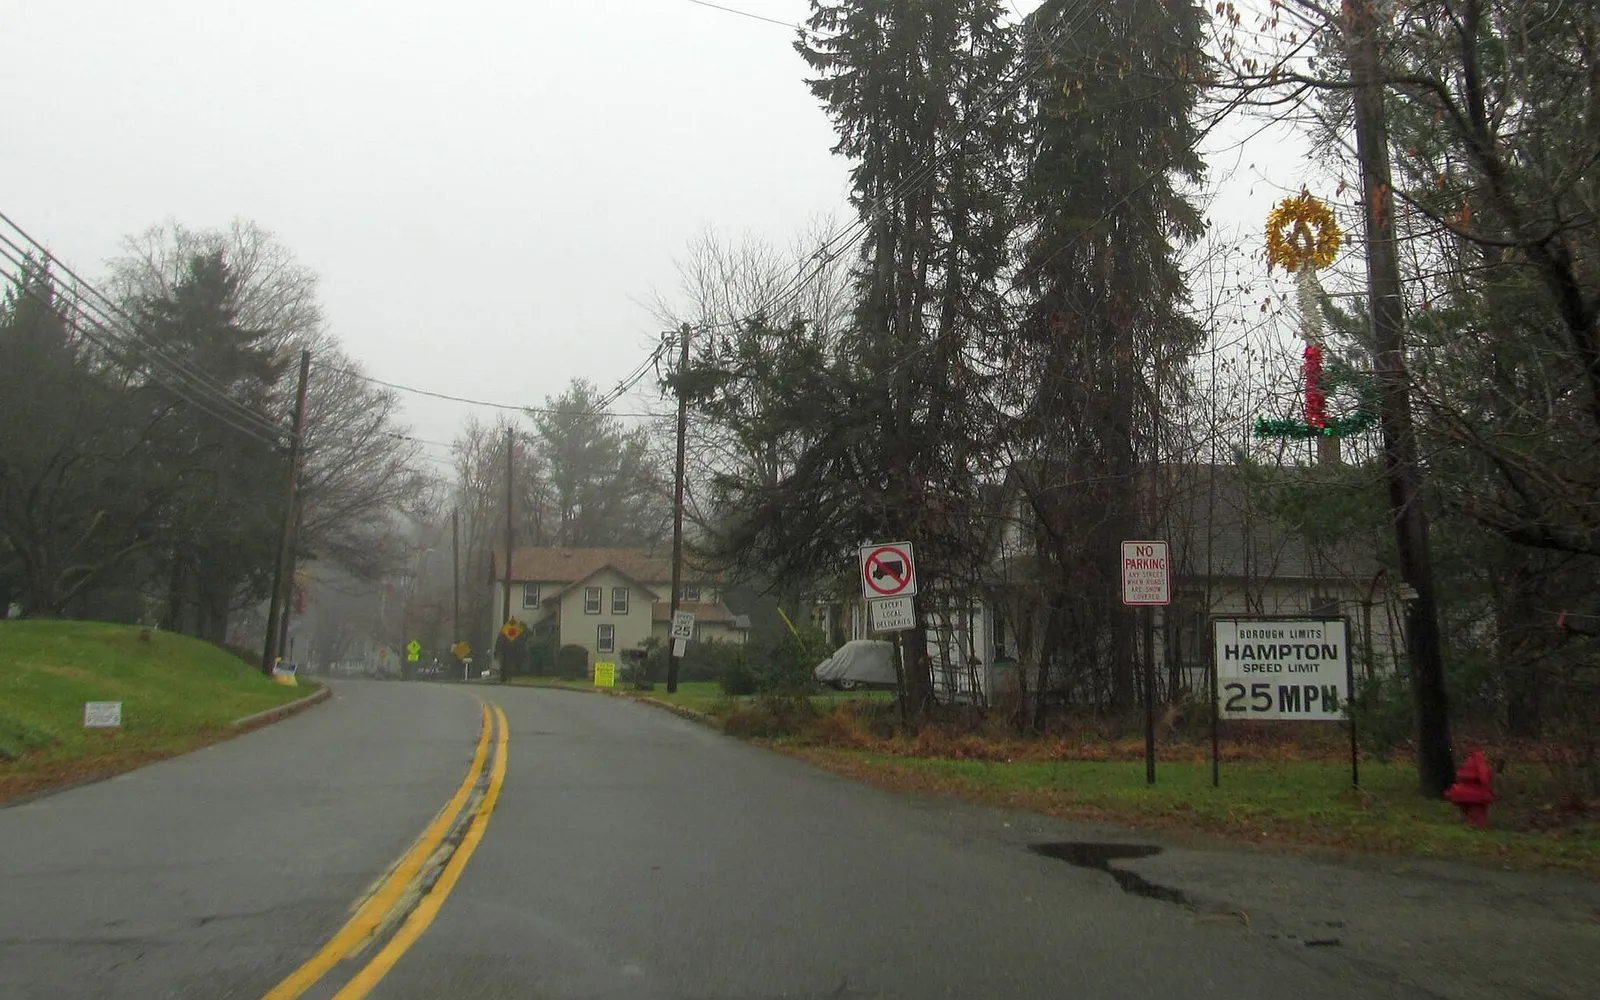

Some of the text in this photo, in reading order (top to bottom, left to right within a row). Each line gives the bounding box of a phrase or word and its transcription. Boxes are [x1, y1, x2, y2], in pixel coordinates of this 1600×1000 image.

[1136, 545, 1154, 557] NO
[1125, 558, 1165, 570] PARKING
[1143, 570, 1163, 578] STREET
[880, 600, 903, 609] EXCEPT
[882, 610, 902, 618] LOCAL
[876, 618, 911, 628] DELIVERIES
[674, 625, 691, 637] 25
[1240, 629, 1322, 639] BOROUGH LIMITS
[1224, 644, 1338, 660] HAMPTON
[1243, 663, 1320, 673] SPEED LIMIT
[1224, 682, 1273, 712] 25
